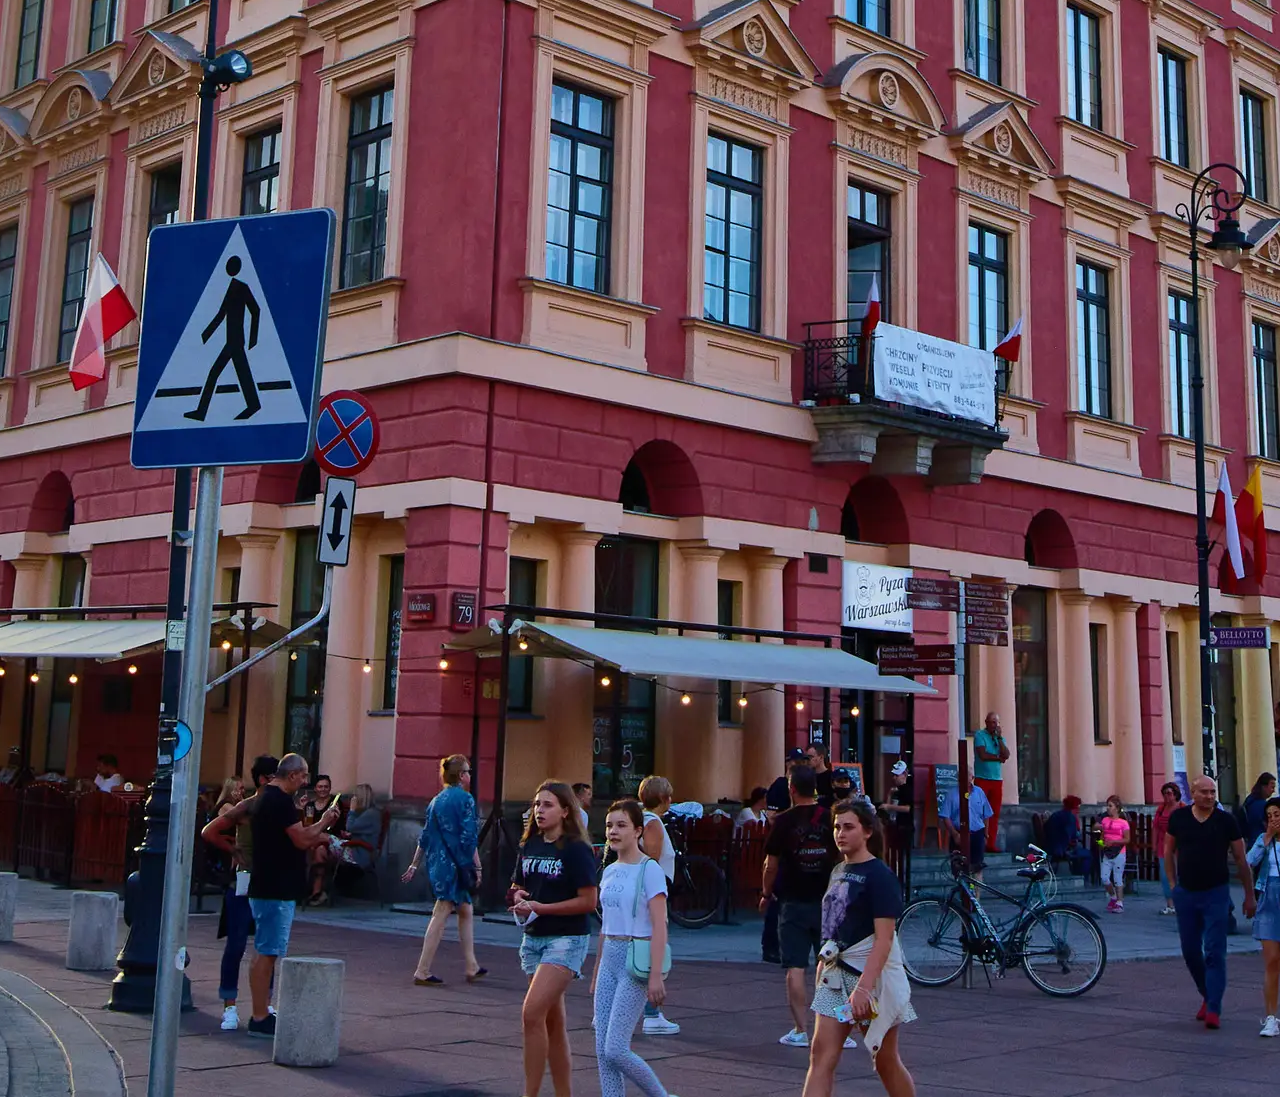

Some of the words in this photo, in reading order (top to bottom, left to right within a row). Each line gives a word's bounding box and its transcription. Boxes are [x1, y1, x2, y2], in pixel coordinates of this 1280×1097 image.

[885, 347, 919, 362] CHRZCINY
[889, 363, 916, 377] WESELA
[927, 378, 951, 392] EVENTY
[879, 576, 904, 596] Pyza
[409, 601, 431, 611] Miodowa
[458, 606, 473, 623] 79
[1220, 630, 1264, 639] BELLOTTO
